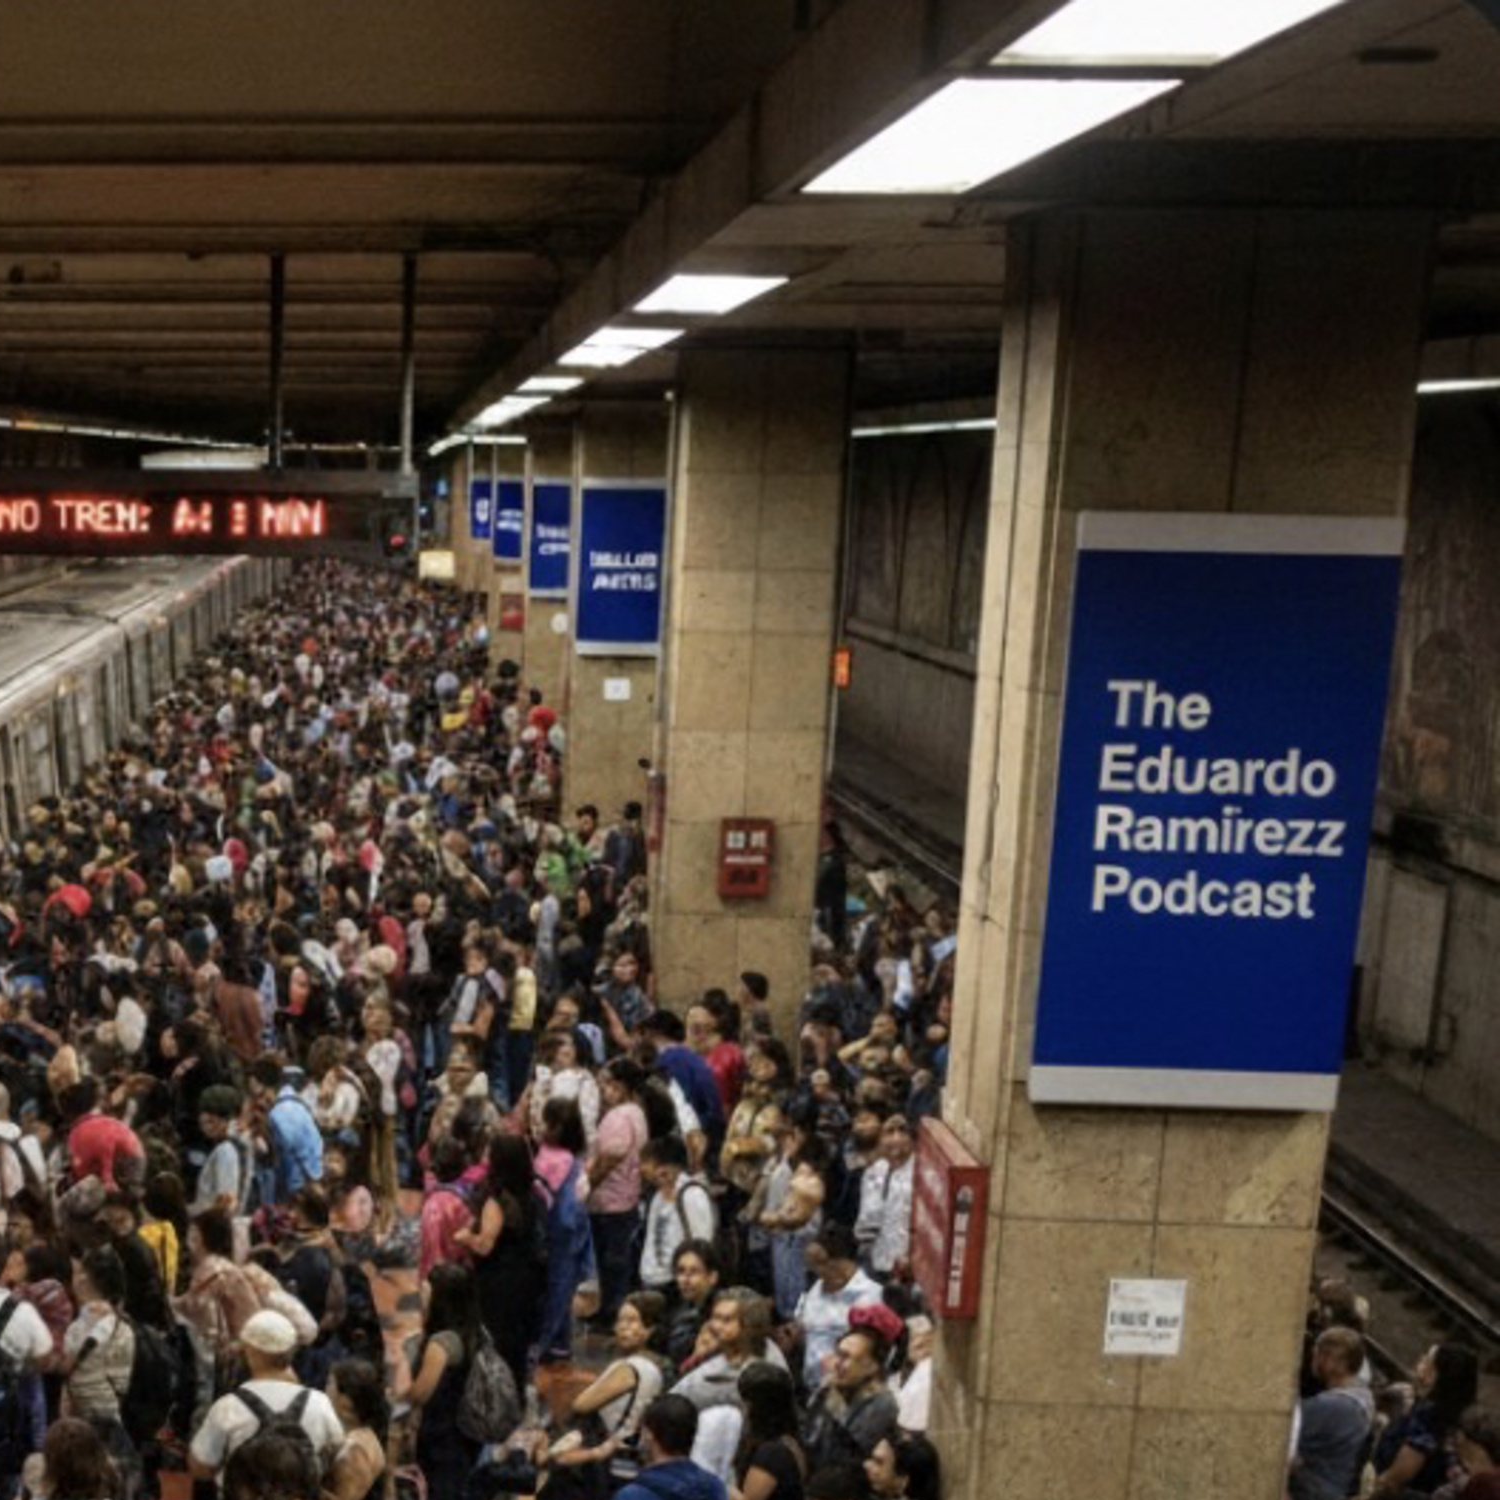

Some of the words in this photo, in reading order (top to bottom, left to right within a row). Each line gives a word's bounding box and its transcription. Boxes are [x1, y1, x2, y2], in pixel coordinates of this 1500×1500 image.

[1108, 681, 1211, 730] The
[1099, 744, 1337, 797] Eduardo
[1093, 804, 1346, 857] Ramirezz
[1092, 865, 1316, 919] Podcast
